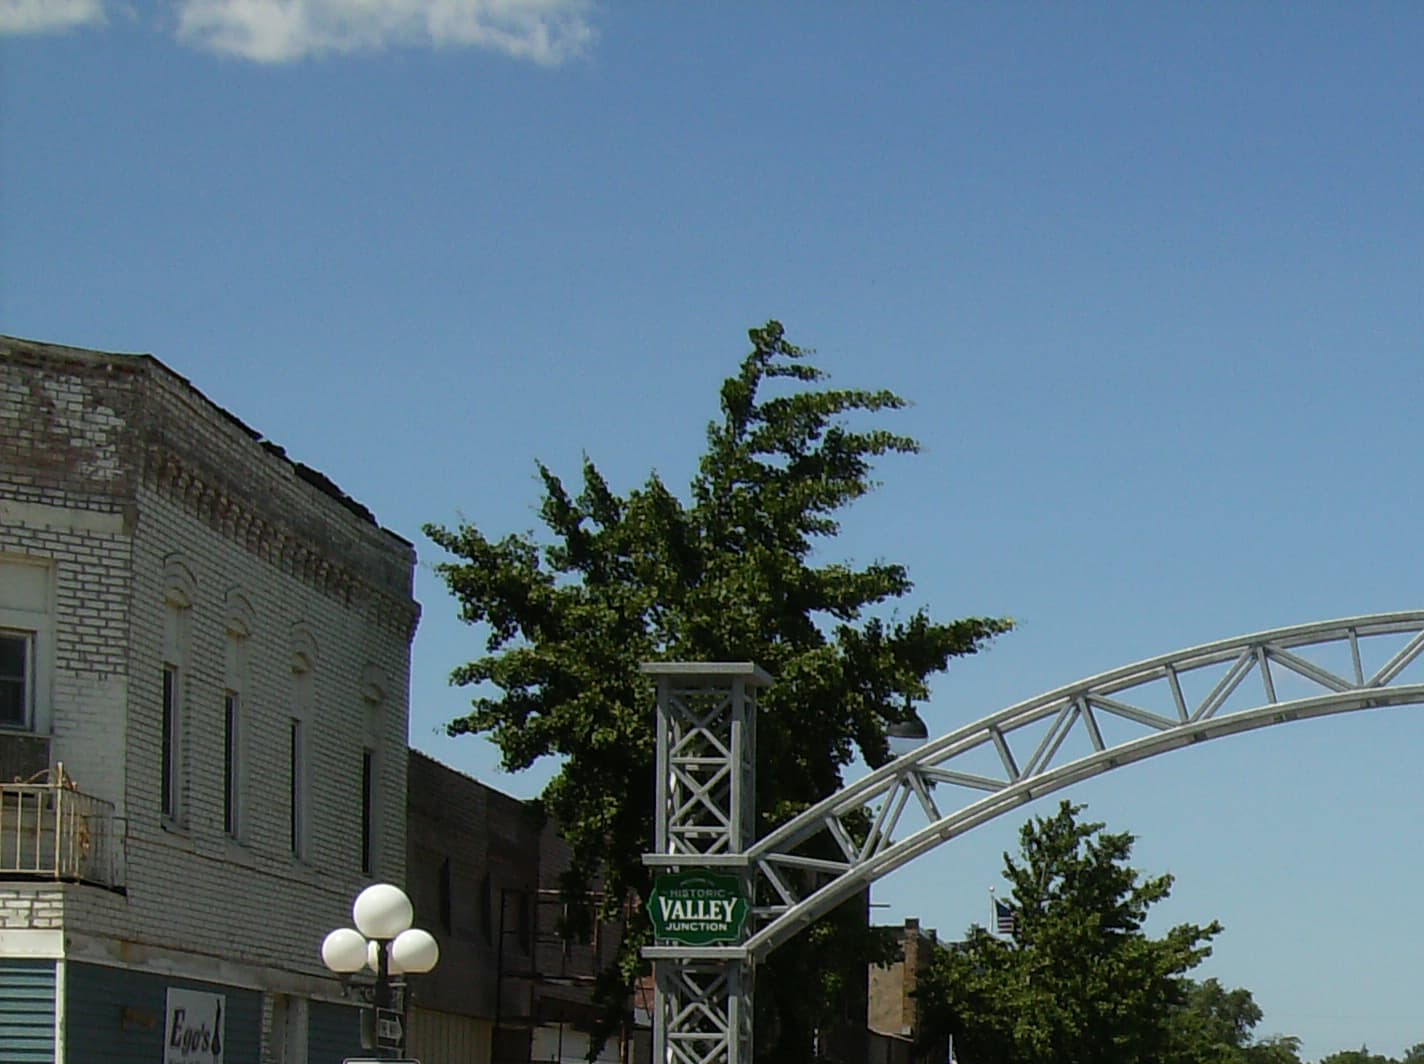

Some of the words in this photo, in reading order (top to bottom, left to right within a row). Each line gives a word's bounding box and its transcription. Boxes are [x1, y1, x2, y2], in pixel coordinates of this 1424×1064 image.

[670, 889, 727, 897] HISTORIC
[658, 895, 738, 923] VALLEY
[665, 922, 728, 931] JUNCTION
[170, 1009, 211, 1056] Ego's
